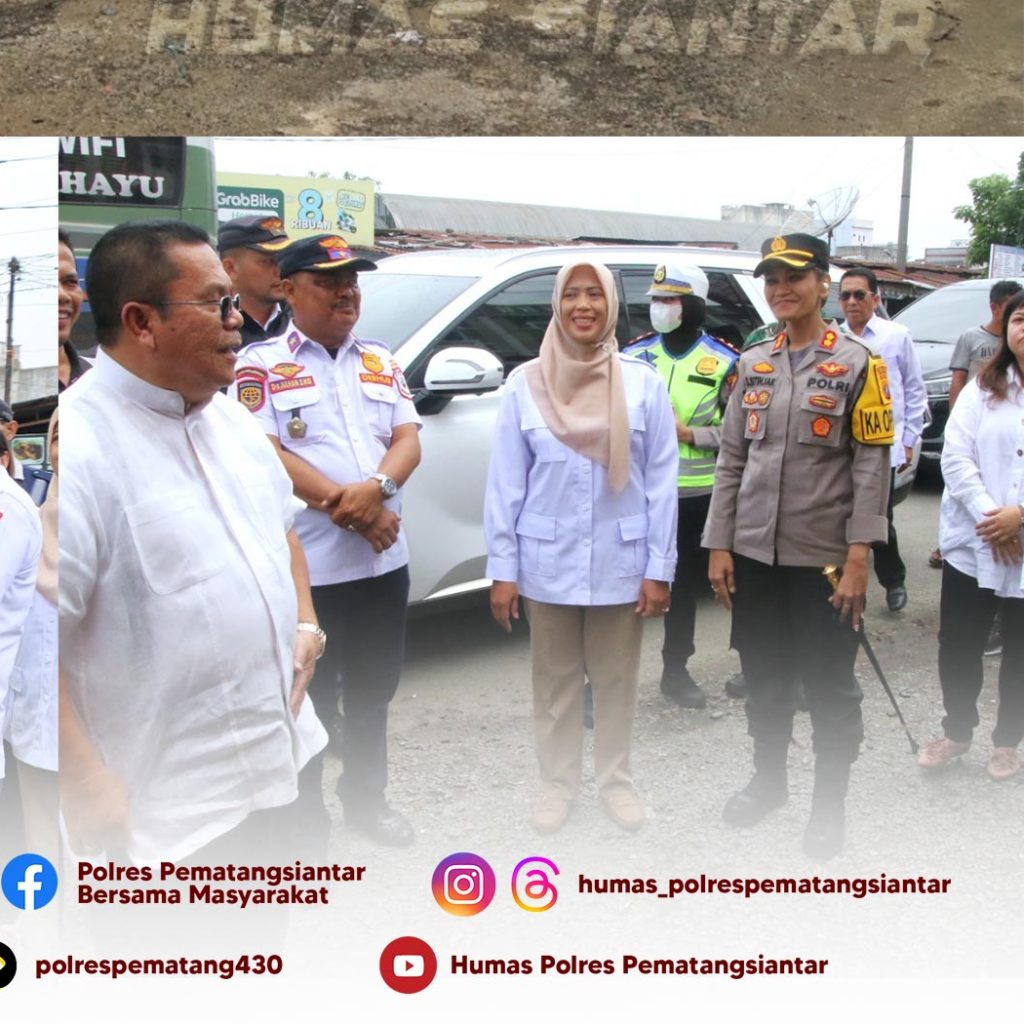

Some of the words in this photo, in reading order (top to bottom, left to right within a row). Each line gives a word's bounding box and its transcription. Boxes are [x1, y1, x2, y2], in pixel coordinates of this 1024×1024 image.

[217, 192, 280, 208] GrabBike
[291, 219, 332, 231] RIBUAN
[807, 377, 851, 393] POLRI
[866, 411, 881, 435] KA
